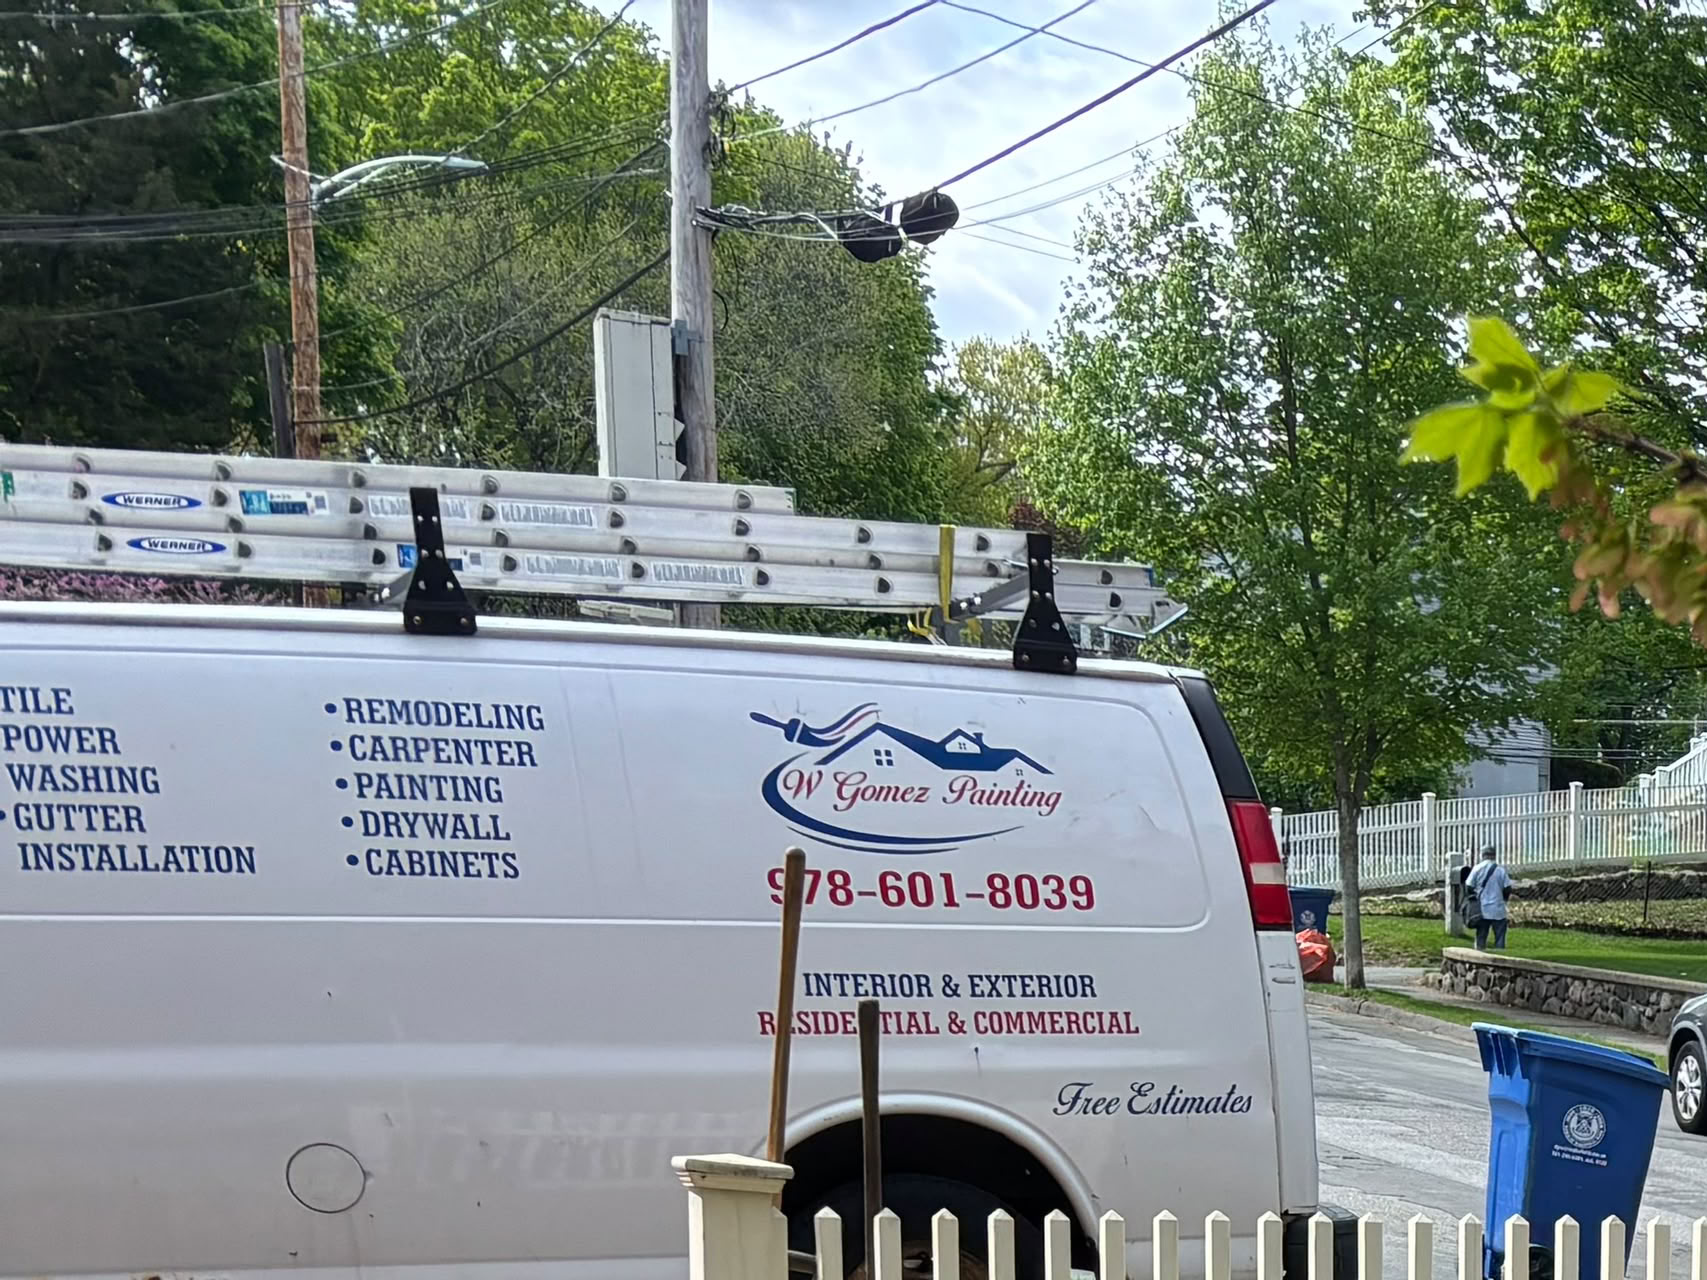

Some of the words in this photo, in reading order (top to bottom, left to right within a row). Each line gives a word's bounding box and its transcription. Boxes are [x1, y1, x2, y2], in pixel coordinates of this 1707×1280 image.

[122, 495, 182, 506] WERNER
[147, 539, 206, 551] WERNER
[0, 685, 75, 716] TILE
[342, 697, 545, 731] REMODELING
[0, 724, 122, 755] POWER
[349, 734, 539, 767] CARPENTER
[4, 763, 161, 794] WASHING
[353, 772, 504, 804] PAINTING
[782, 769, 823, 801] W
[832, 771, 932, 812] Gomez
[941, 774, 1063, 817] Painting
[13, 802, 147, 834] GUTTER
[359, 810, 512, 841] DRYWALL
[17, 842, 257, 875] INSTALLATION
[365, 848, 520, 879] CABINETS
[767, 867, 1096, 911] 978-601-8039
[802, 972, 934, 998] INTERIOR
[941, 974, 962, 998] &
[967, 974, 1098, 999] EXTERIOR
[757, 1010, 940, 1036] RSIDETIAL
[947, 1011, 968, 1035] &
[973, 1011, 1141, 1036] COMMERCIAL
[1052, 1082, 1121, 1116] Free
[1127, 1081, 1253, 1116] Estimates
